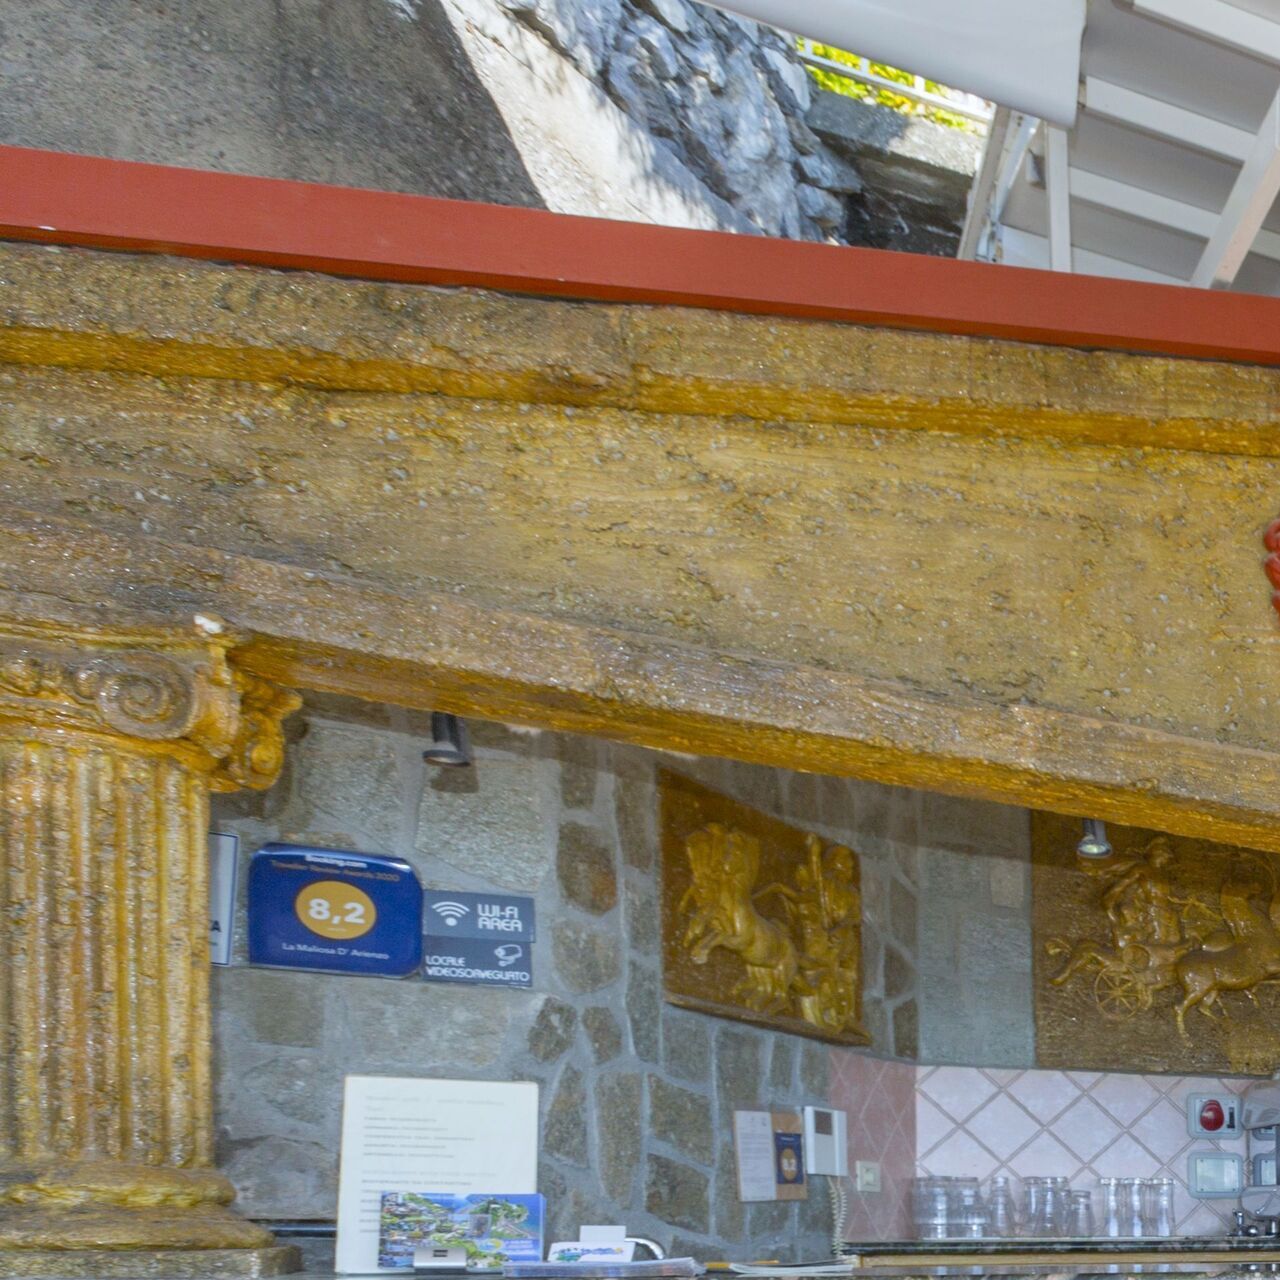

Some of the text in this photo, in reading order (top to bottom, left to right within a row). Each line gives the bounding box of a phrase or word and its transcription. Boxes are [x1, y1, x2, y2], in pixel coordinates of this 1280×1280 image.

[308, 898, 365, 925] 8,2
[476, 903, 519, 919] WI-FI
[477, 918, 523, 932] AREA
[282, 942, 295, 951] La
[425, 954, 467, 967] LOCALE
